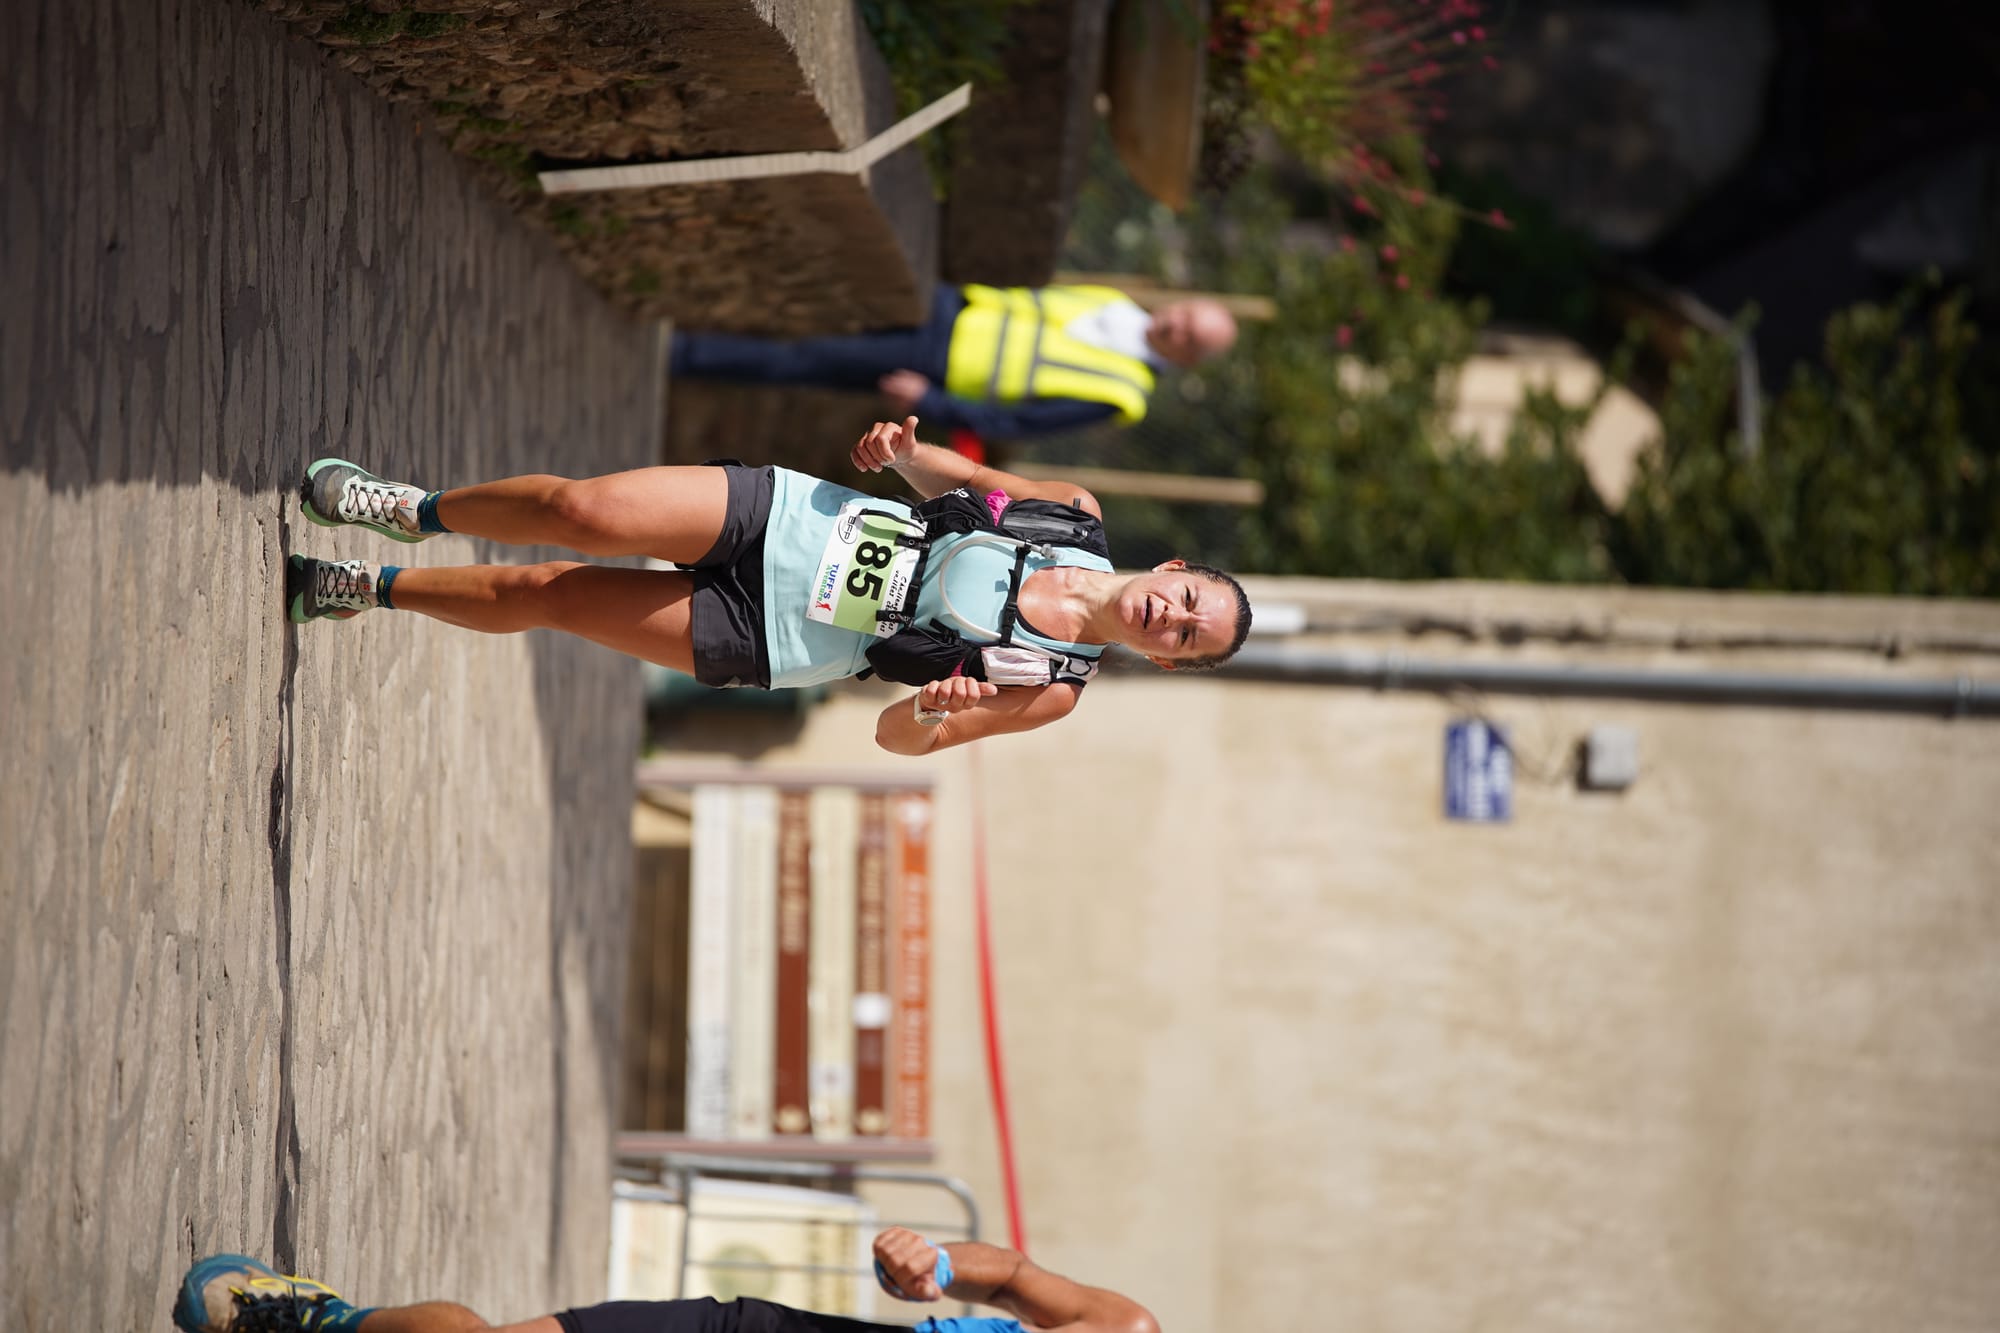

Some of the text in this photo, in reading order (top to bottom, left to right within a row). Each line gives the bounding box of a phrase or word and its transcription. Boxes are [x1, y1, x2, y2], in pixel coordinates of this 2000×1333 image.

[817, 564, 832, 602] Aventure
[823, 563, 840, 600] TUFF'S
[846, 541, 892, 601] 85
[892, 576, 907, 611] Challeng
